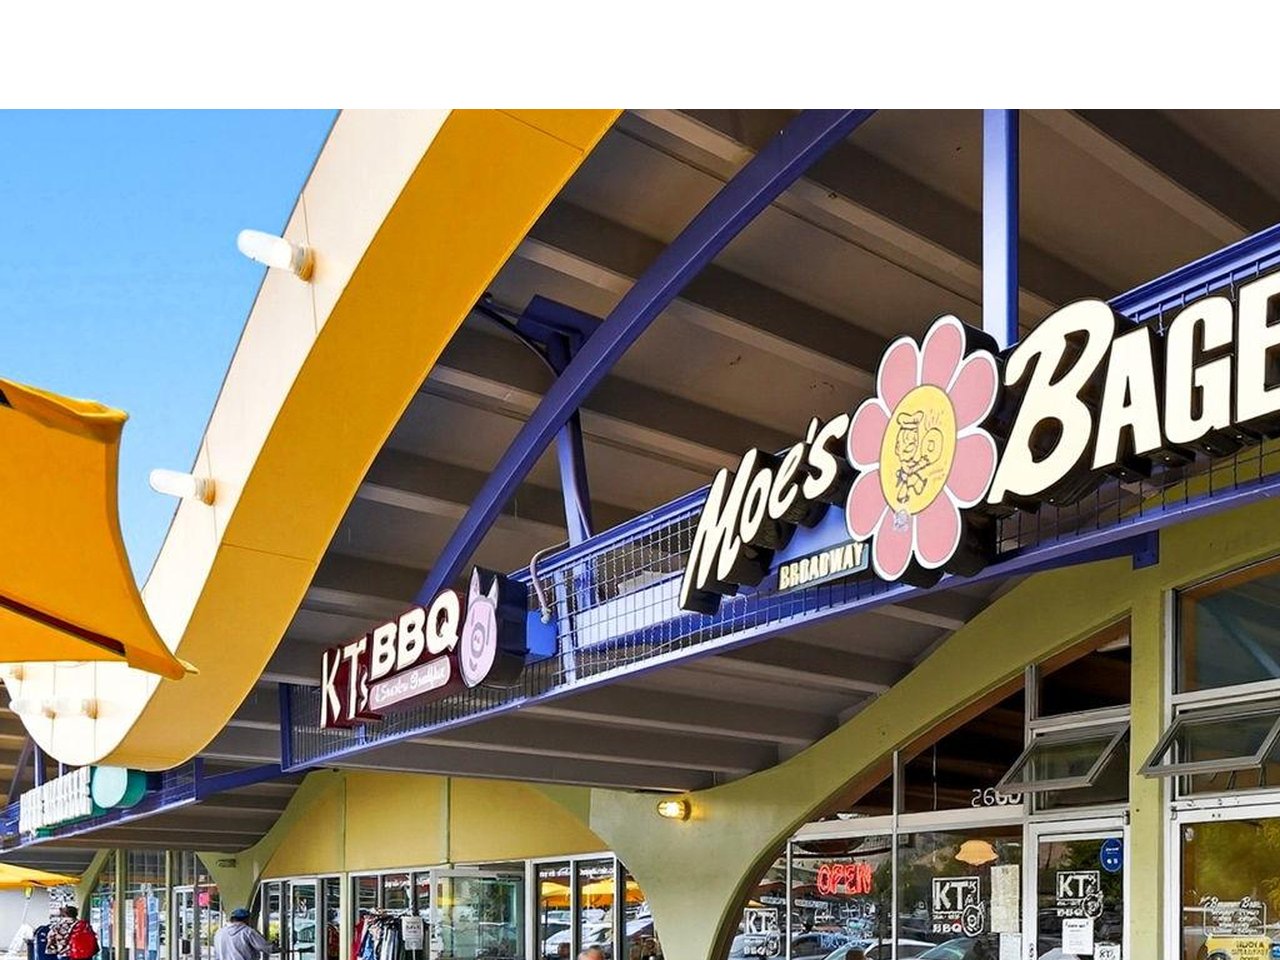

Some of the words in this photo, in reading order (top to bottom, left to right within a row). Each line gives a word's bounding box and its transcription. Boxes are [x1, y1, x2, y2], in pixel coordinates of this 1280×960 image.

[680, 413, 850, 610] Moe's
[779, 543, 864, 591] BROADWAY
[370, 589, 459, 682] BBQ
[817, 863, 872, 895] OPEN
